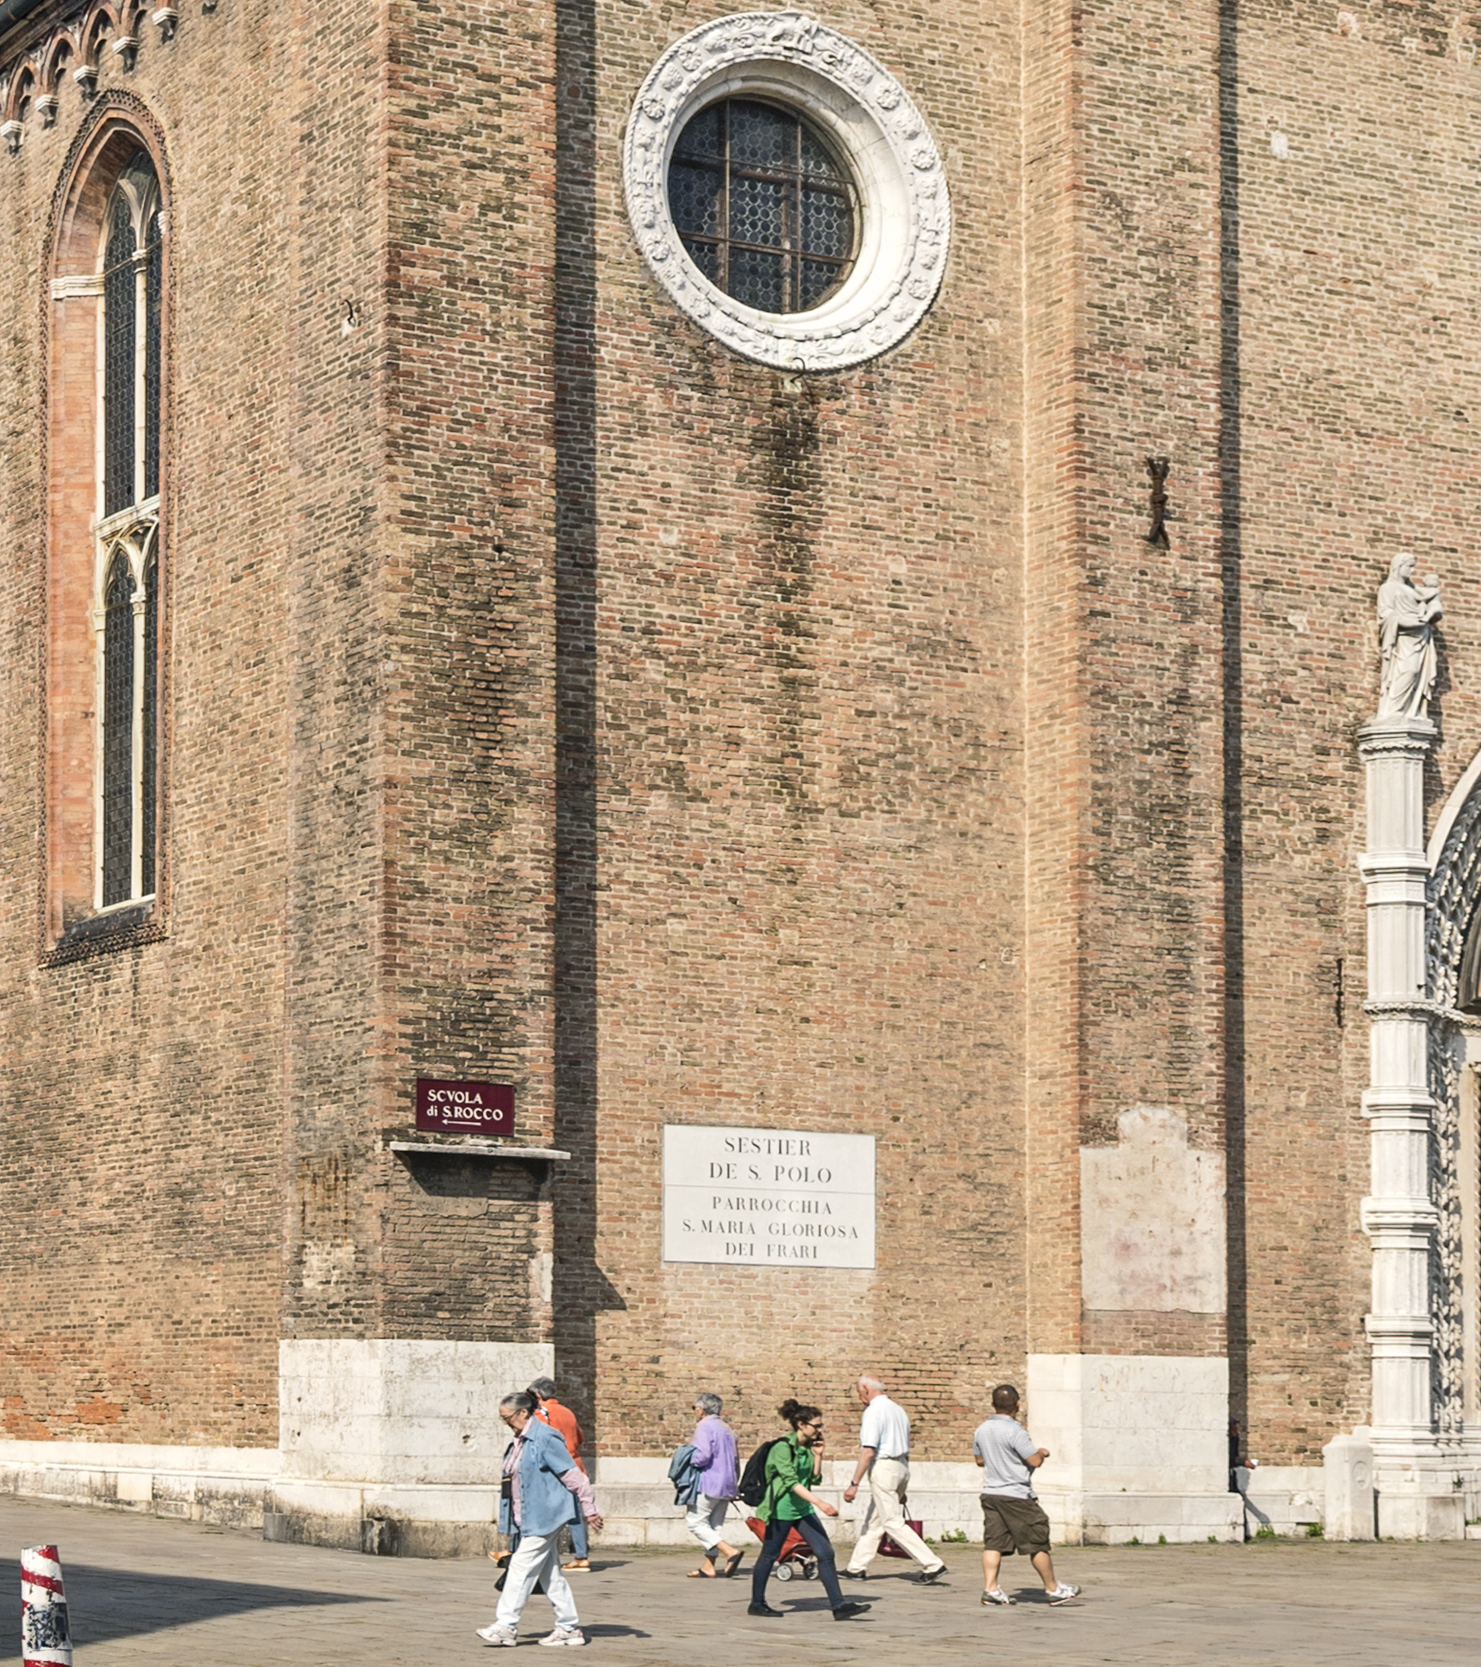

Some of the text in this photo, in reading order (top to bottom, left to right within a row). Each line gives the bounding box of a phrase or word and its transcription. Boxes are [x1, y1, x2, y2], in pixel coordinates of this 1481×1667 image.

[427, 1089, 483, 1104] SCVOLA
[426, 1105, 438, 1116] di
[724, 1137, 812, 1156] SESTIER
[709, 1162, 832, 1184] DE S. POLO
[712, 1196, 832, 1215] PARROCCHIA
[682, 1219, 859, 1239] S. MARIA GLORIOSA
[725, 1242, 818, 1259] DEI FRARI
